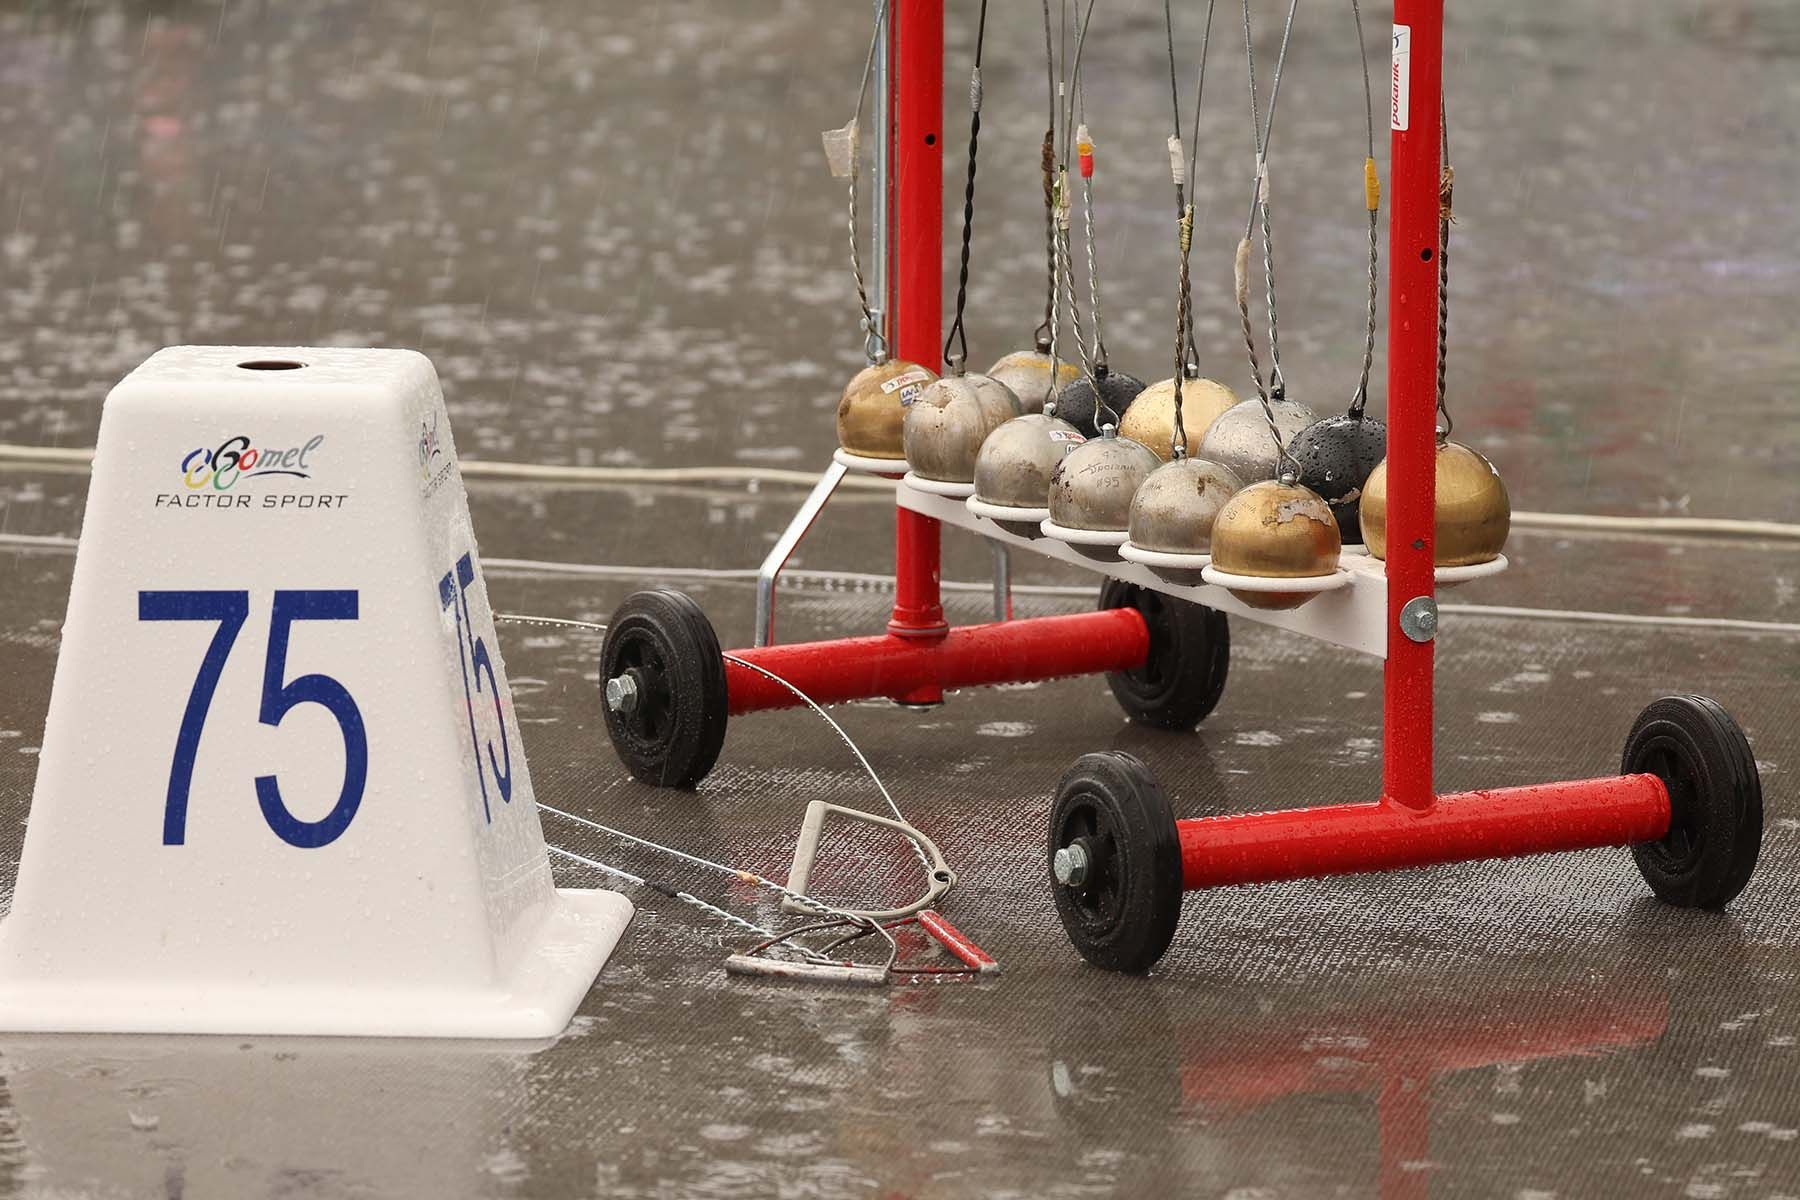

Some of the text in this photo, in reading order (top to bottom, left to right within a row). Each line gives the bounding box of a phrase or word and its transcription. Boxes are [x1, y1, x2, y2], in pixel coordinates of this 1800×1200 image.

[1392, 62, 1401, 127] polanik
[211, 434, 325, 472] Gomel
[154, 494, 349, 509] FACTOR SPORT
[138, 589, 368, 849] 75
